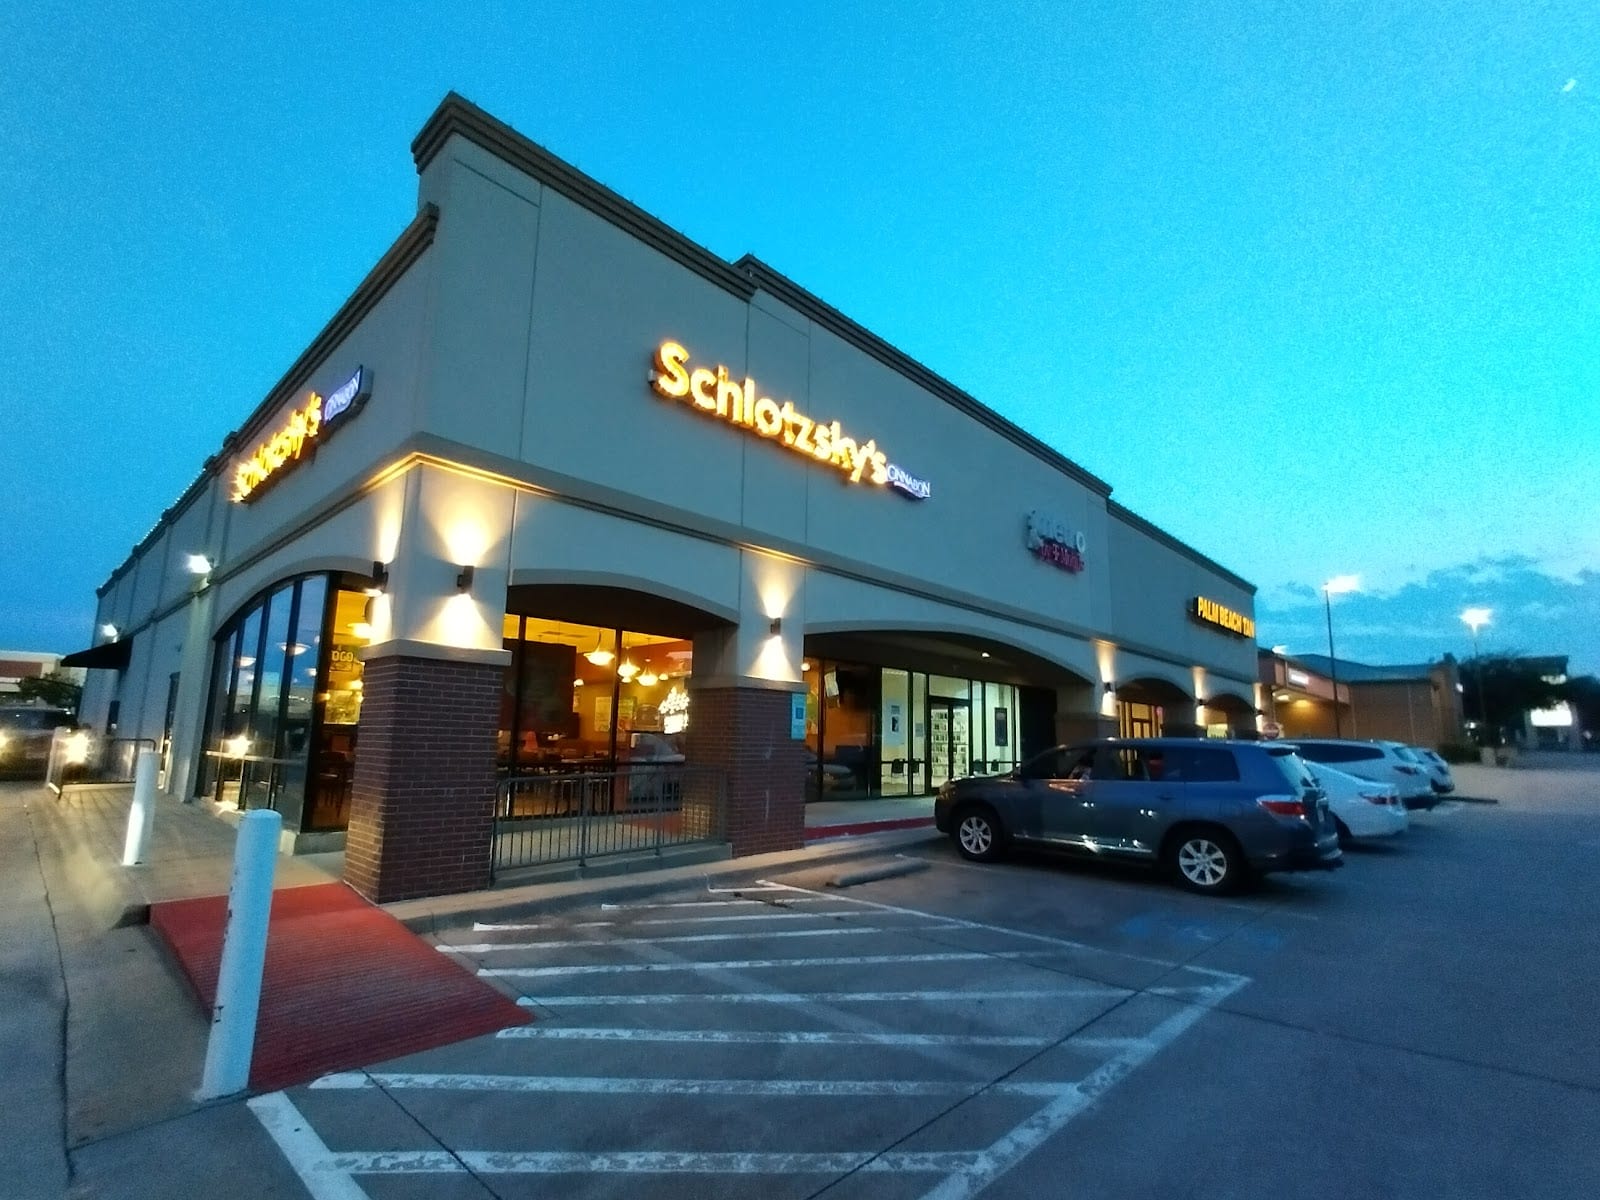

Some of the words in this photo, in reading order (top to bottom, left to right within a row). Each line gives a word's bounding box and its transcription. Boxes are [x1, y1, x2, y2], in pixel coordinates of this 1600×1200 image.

[657, 341, 888, 485] Schlotzsky's
[1198, 596, 1219, 624] PALM
[1219, 606, 1242, 634] BEACH
[1243, 616, 1256, 638] TAN
